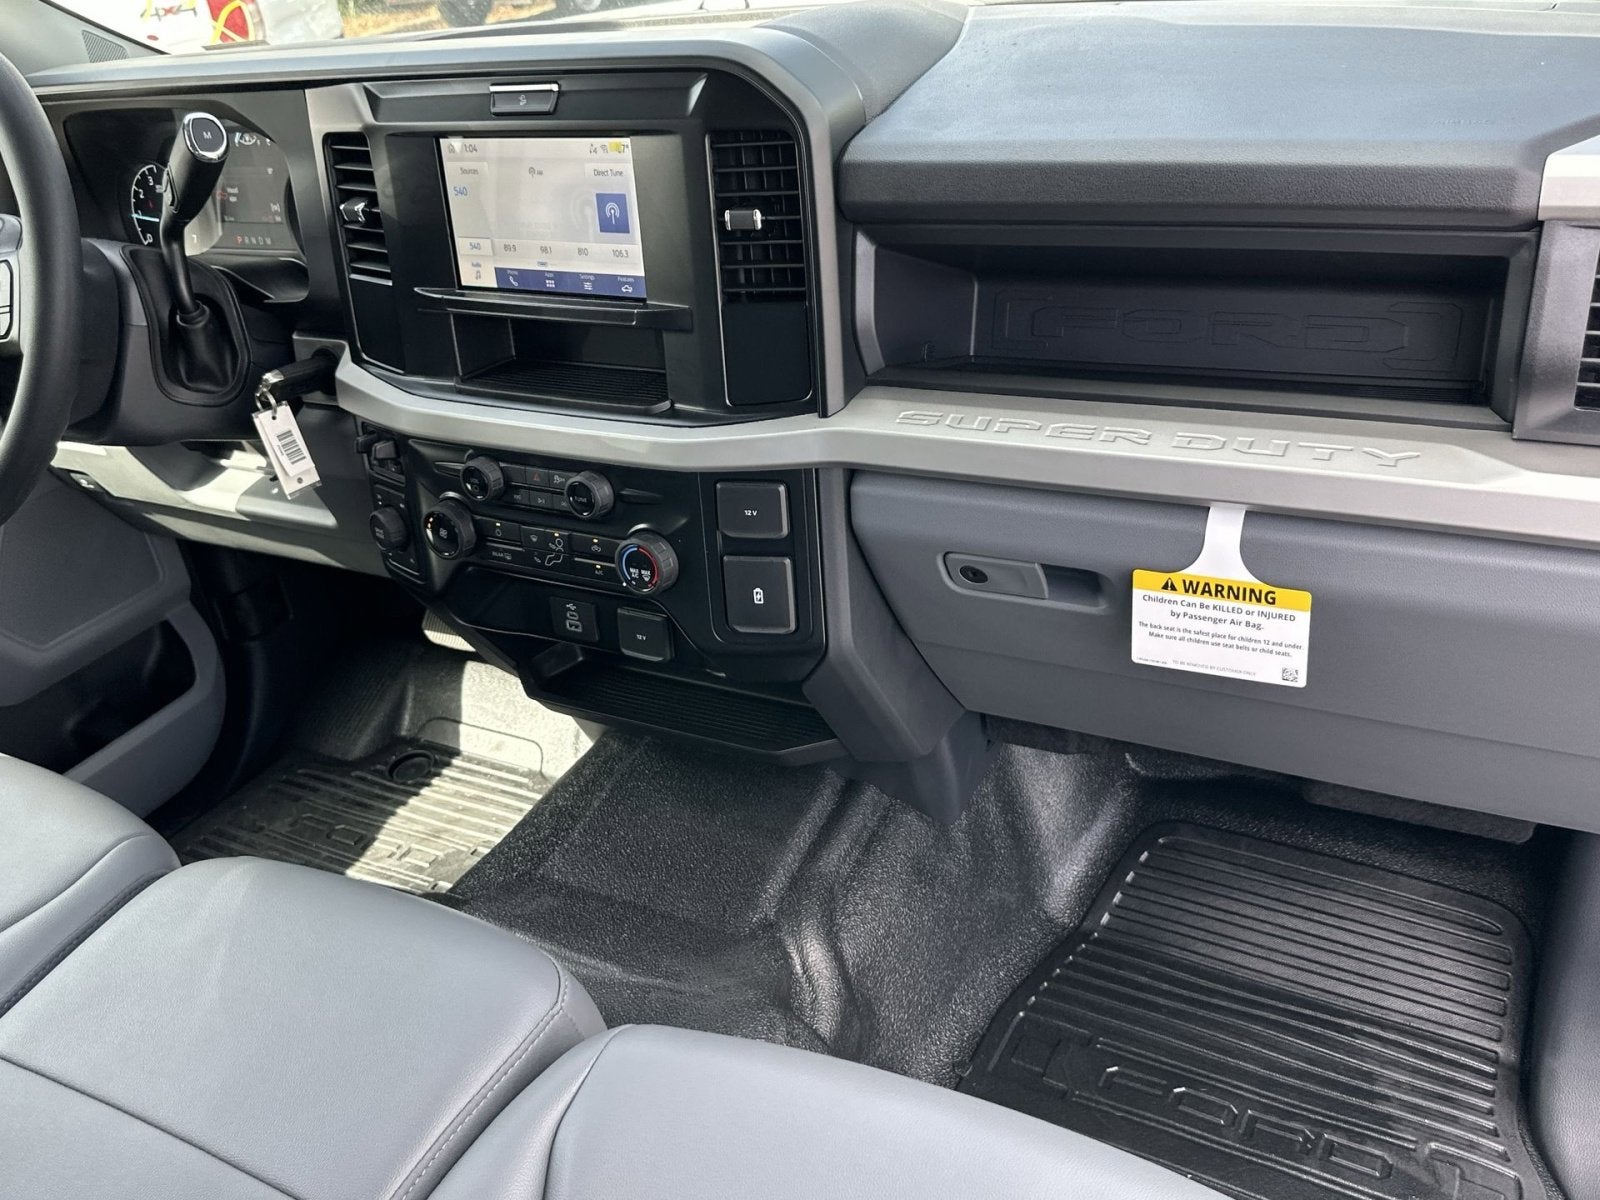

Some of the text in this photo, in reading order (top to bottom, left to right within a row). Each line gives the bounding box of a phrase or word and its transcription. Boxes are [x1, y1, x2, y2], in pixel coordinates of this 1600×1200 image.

[203, 131, 212, 140] M
[593, 168, 623, 177] Direct Tune
[139, 189, 145, 199] 2
[453, 186, 468, 196] 540
[469, 242, 482, 251] 540
[577, 247, 589, 257] 810
[895, 409, 1422, 468] SUPER DUTY
[1182, 579, 1276, 606] WARNING
[1142, 594, 1178, 605] Children
[1180, 600, 1197, 608] Can
[1199, 602, 1211, 610] Be
[1212, 604, 1243, 614] KILLED
[1257, 610, 1296, 622] INJURED
[1170, 610, 1264, 631] by Passenger Air Bag.
[1148, 631, 1164, 639] Make
[1186, 637, 1210, 646] children
[1236, 643, 1250, 652] belts
[1193, 629, 1210, 637] safest
[1211, 631, 1227, 639] place
[1228, 632, 1237, 640] for
[1237, 634, 1262, 643] children
[1271, 640, 1283, 648] and
